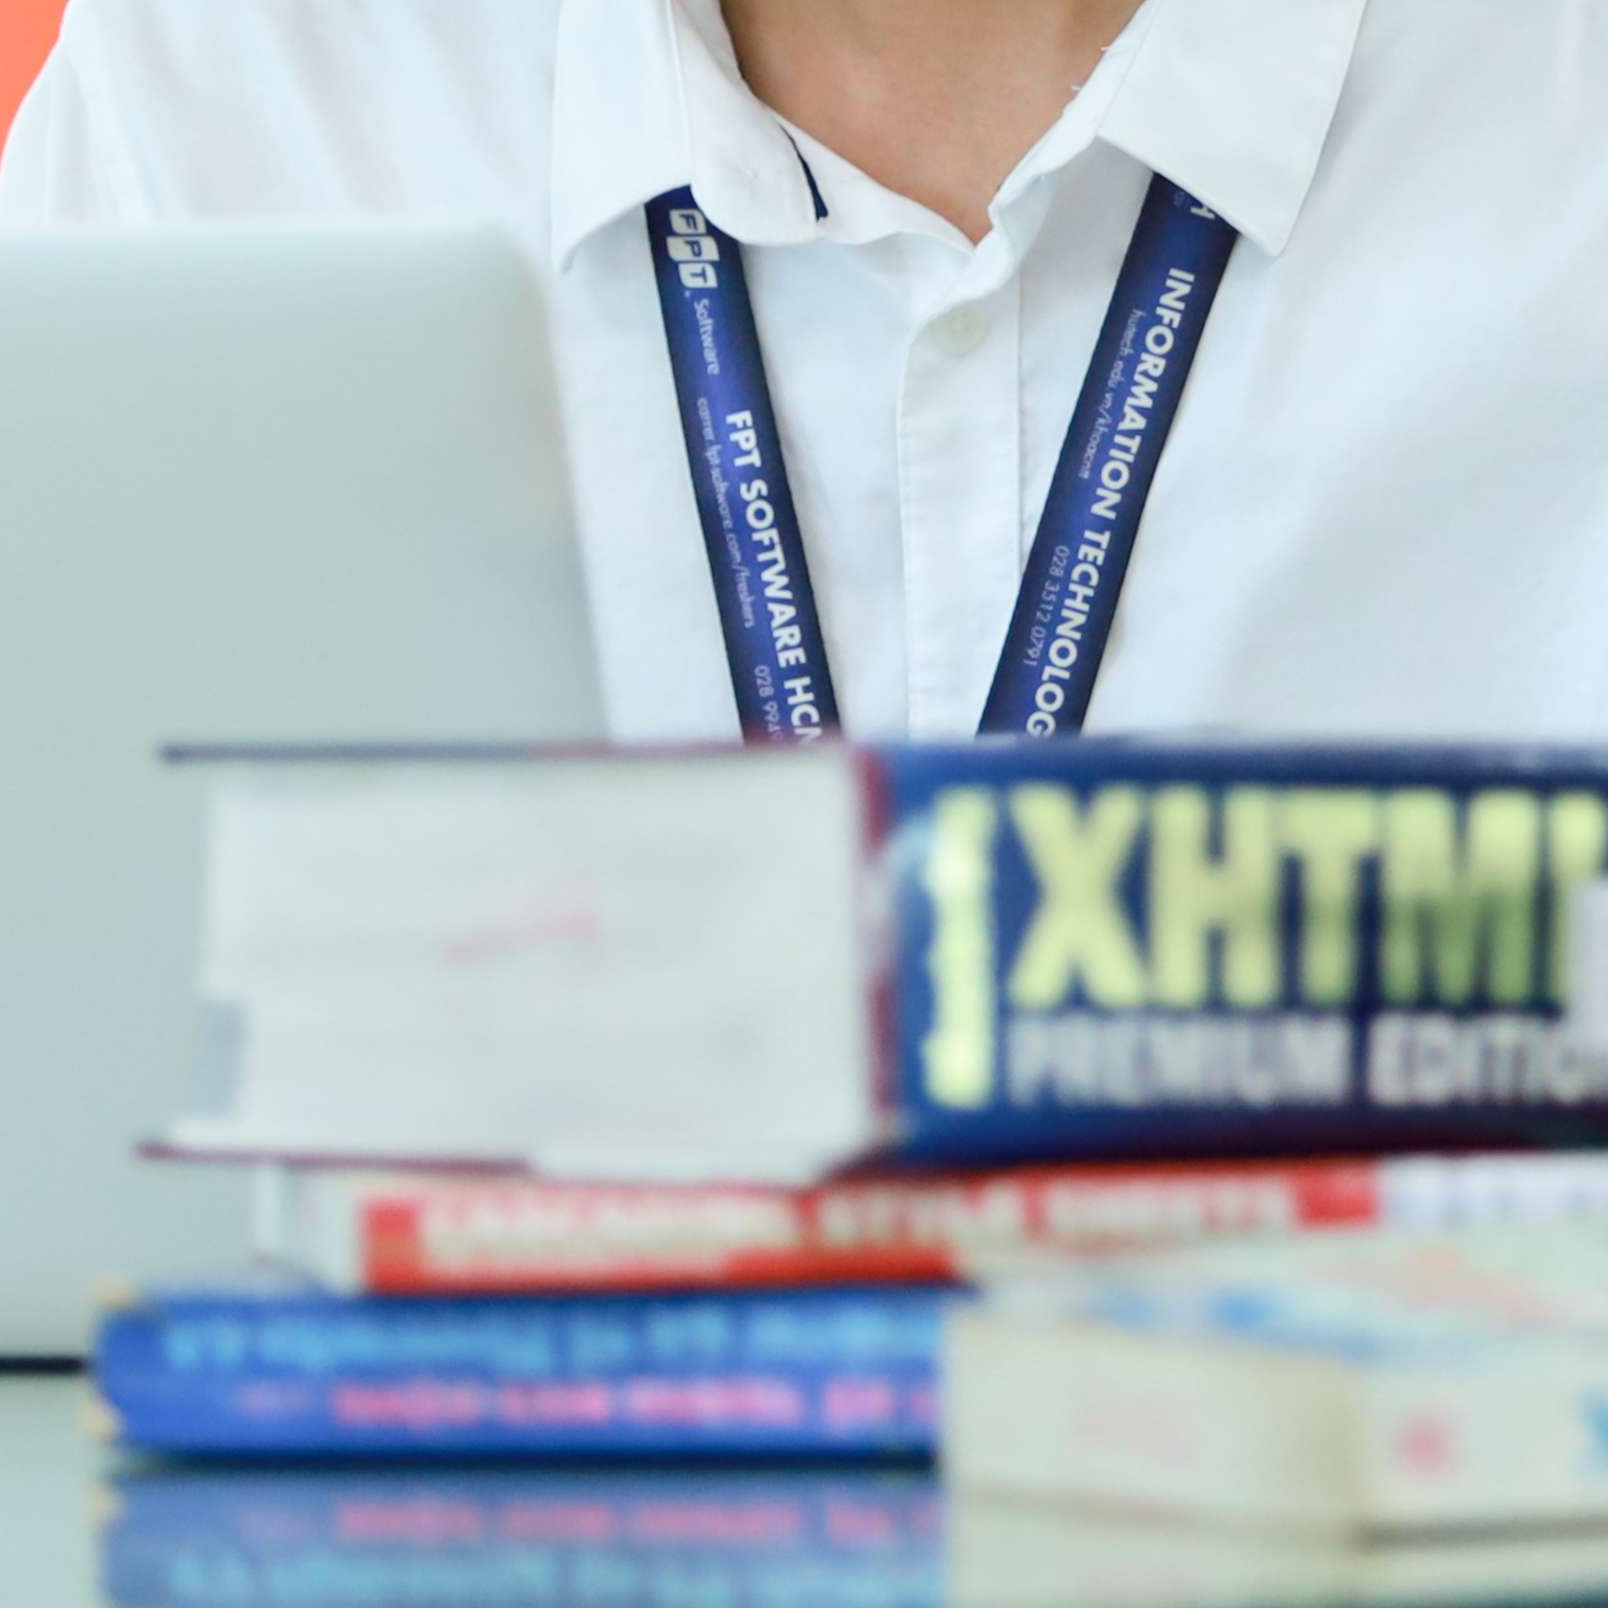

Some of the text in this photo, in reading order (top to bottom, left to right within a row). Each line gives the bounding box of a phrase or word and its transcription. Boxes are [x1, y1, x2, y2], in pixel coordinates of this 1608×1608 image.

[666, 209, 720, 376] FPT Software
[726, 409, 762, 469] FPT
[1090, 267, 1196, 520] INFORMATION
[740, 479, 808, 669] SOFTWARE
[1024, 545, 1070, 666] 028 3512 0791
[754, 665, 774, 698] 028
[1005, 1013, 1355, 1107] PREMIUM
